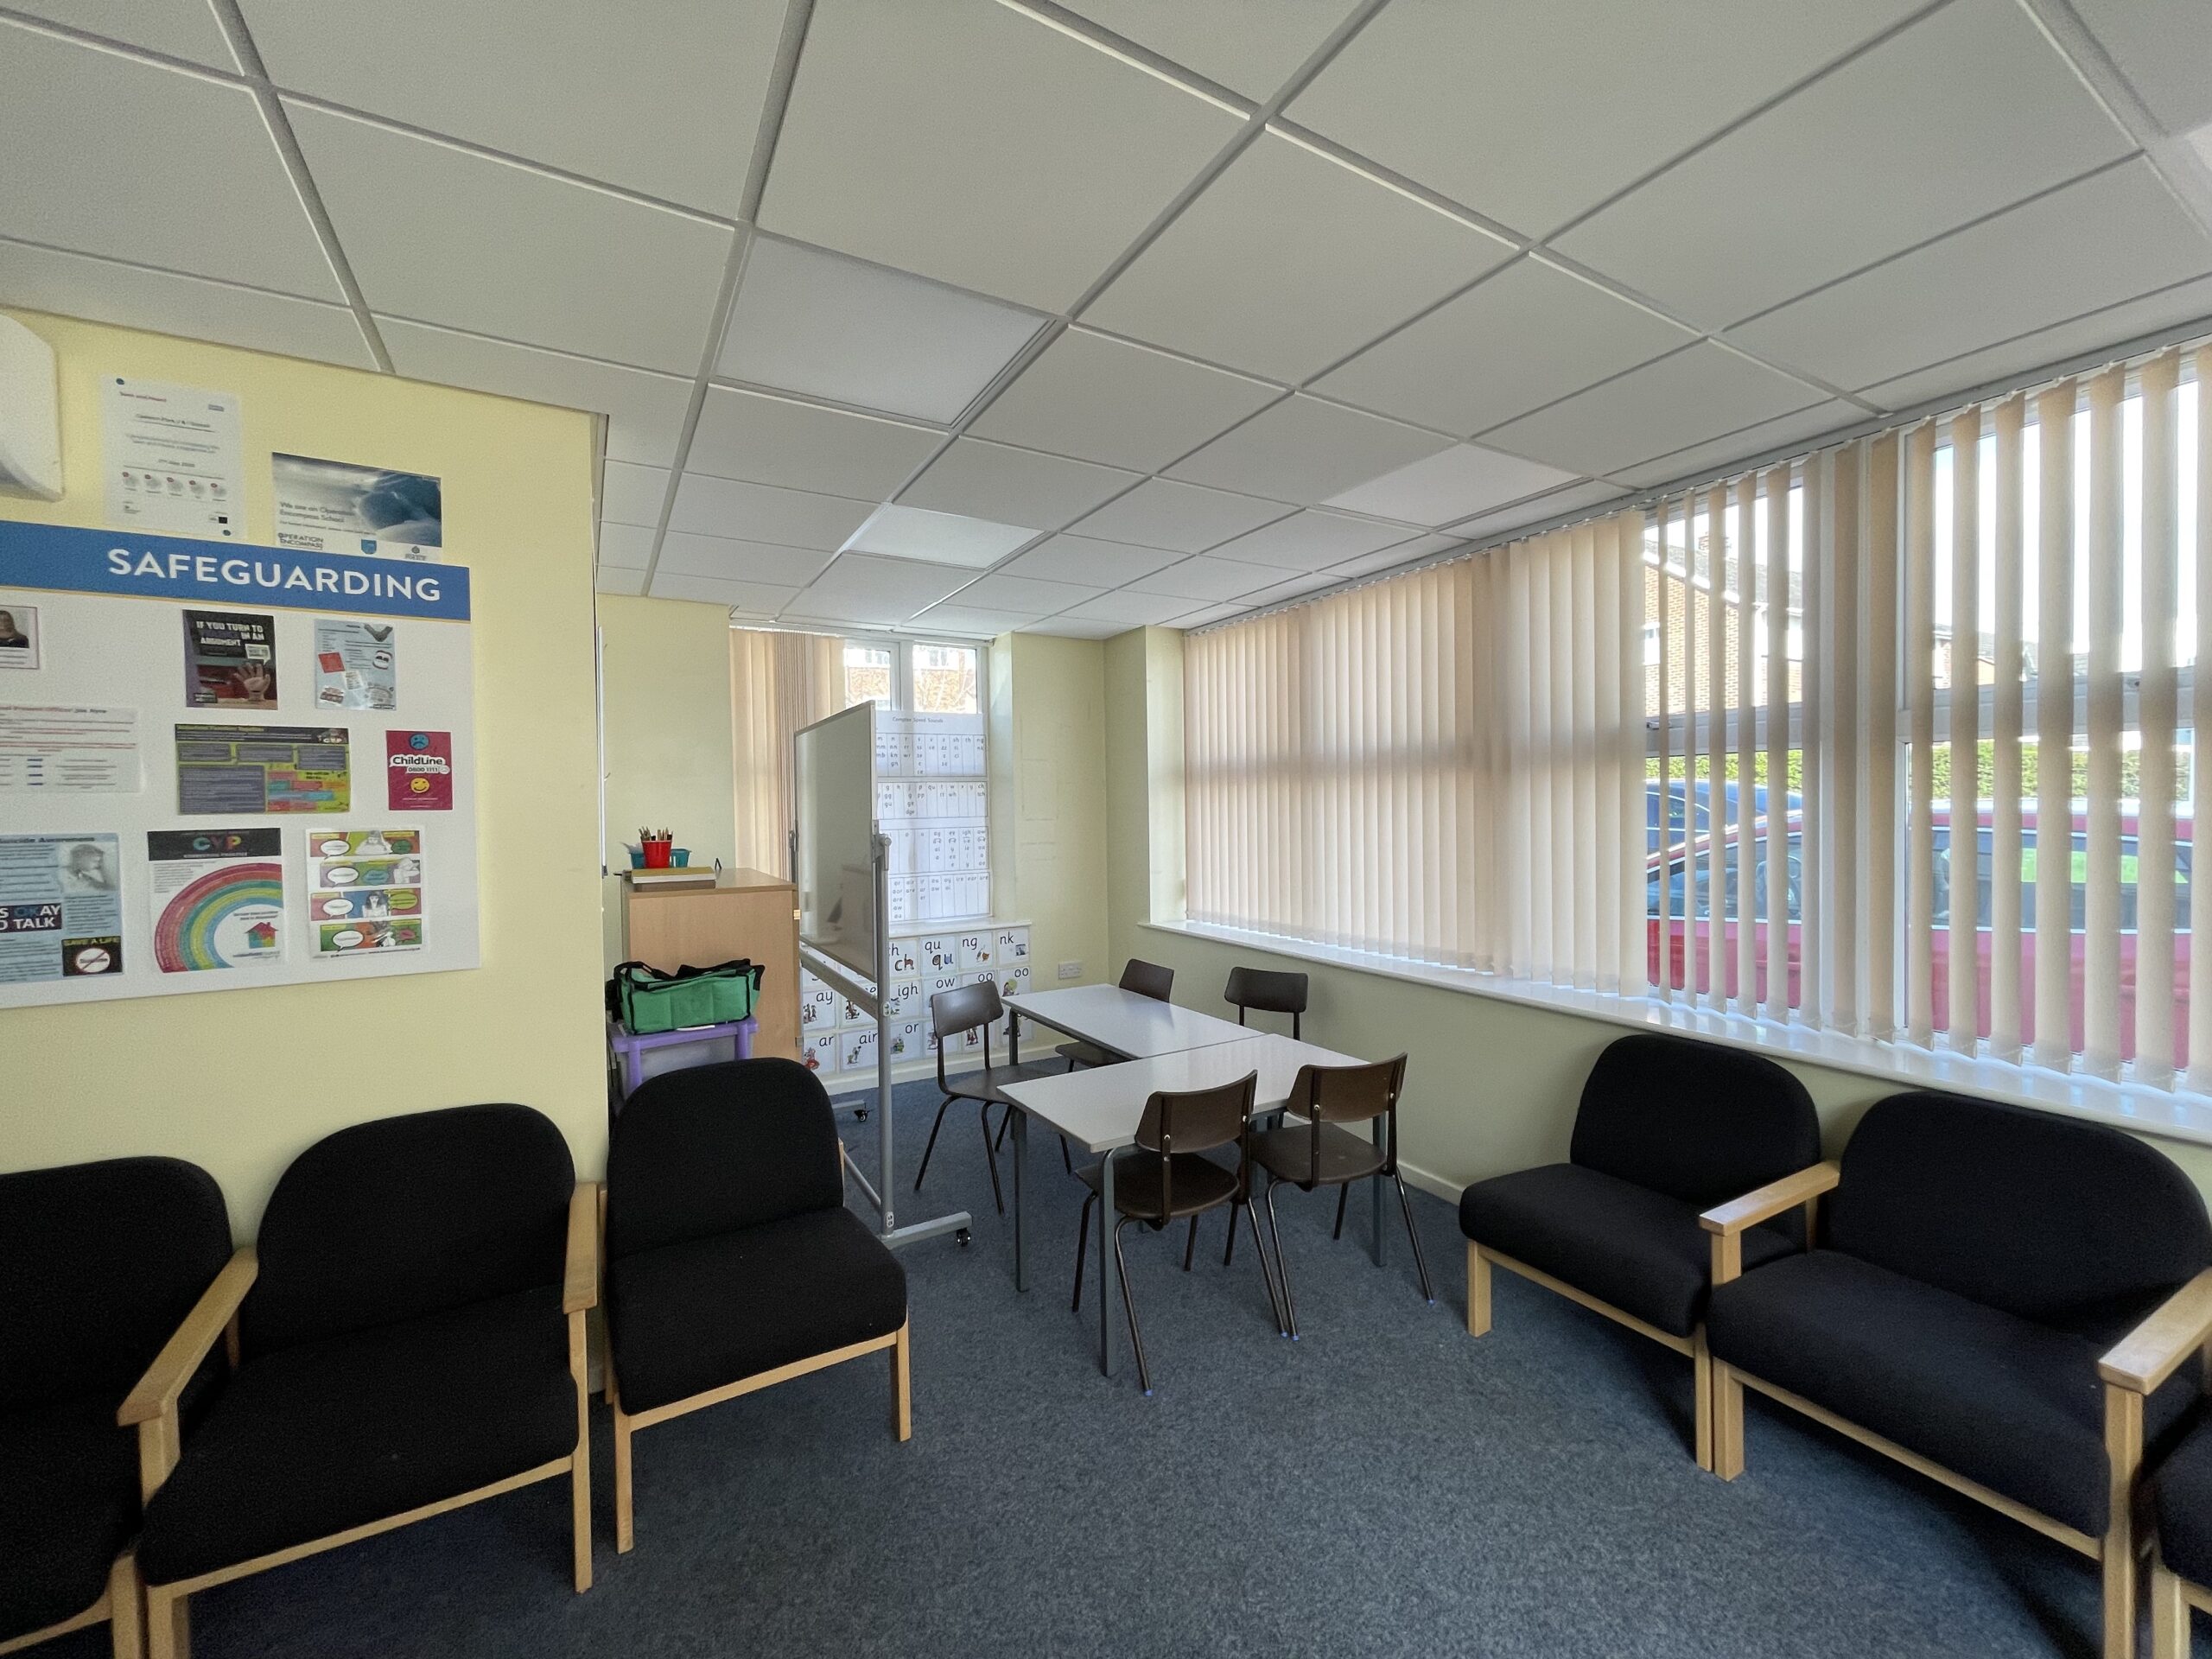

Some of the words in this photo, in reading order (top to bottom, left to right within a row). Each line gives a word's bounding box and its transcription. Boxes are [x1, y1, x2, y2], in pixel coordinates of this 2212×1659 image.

[107, 548, 442, 602] SAFEGUARDING
[196, 620, 205, 629] IF
[206, 621, 226, 630] YOU
[226, 622, 251, 632] TURN
[251, 624, 264, 632] TO
[392, 756, 443, 765] ChildLine
[193, 835, 242, 851] CYP
[13, 917, 56, 930] TALK
[889, 943, 899, 957] h
[925, 941, 942, 954] qu
[962, 938, 977, 950] ng
[1000, 931, 1014, 944] nk
[894, 953, 914, 971] ch
[932, 953, 954, 971] qu
[816, 991, 833, 1006] ay
[898, 982, 918, 1000] igh
[936, 978, 956, 988] ow
[978, 972, 993, 982] oo
[1014, 968, 1029, 978] oo
[818, 1036, 834, 1047] ar
[859, 1031, 878, 1045] air
[905, 1023, 919, 1034] or
